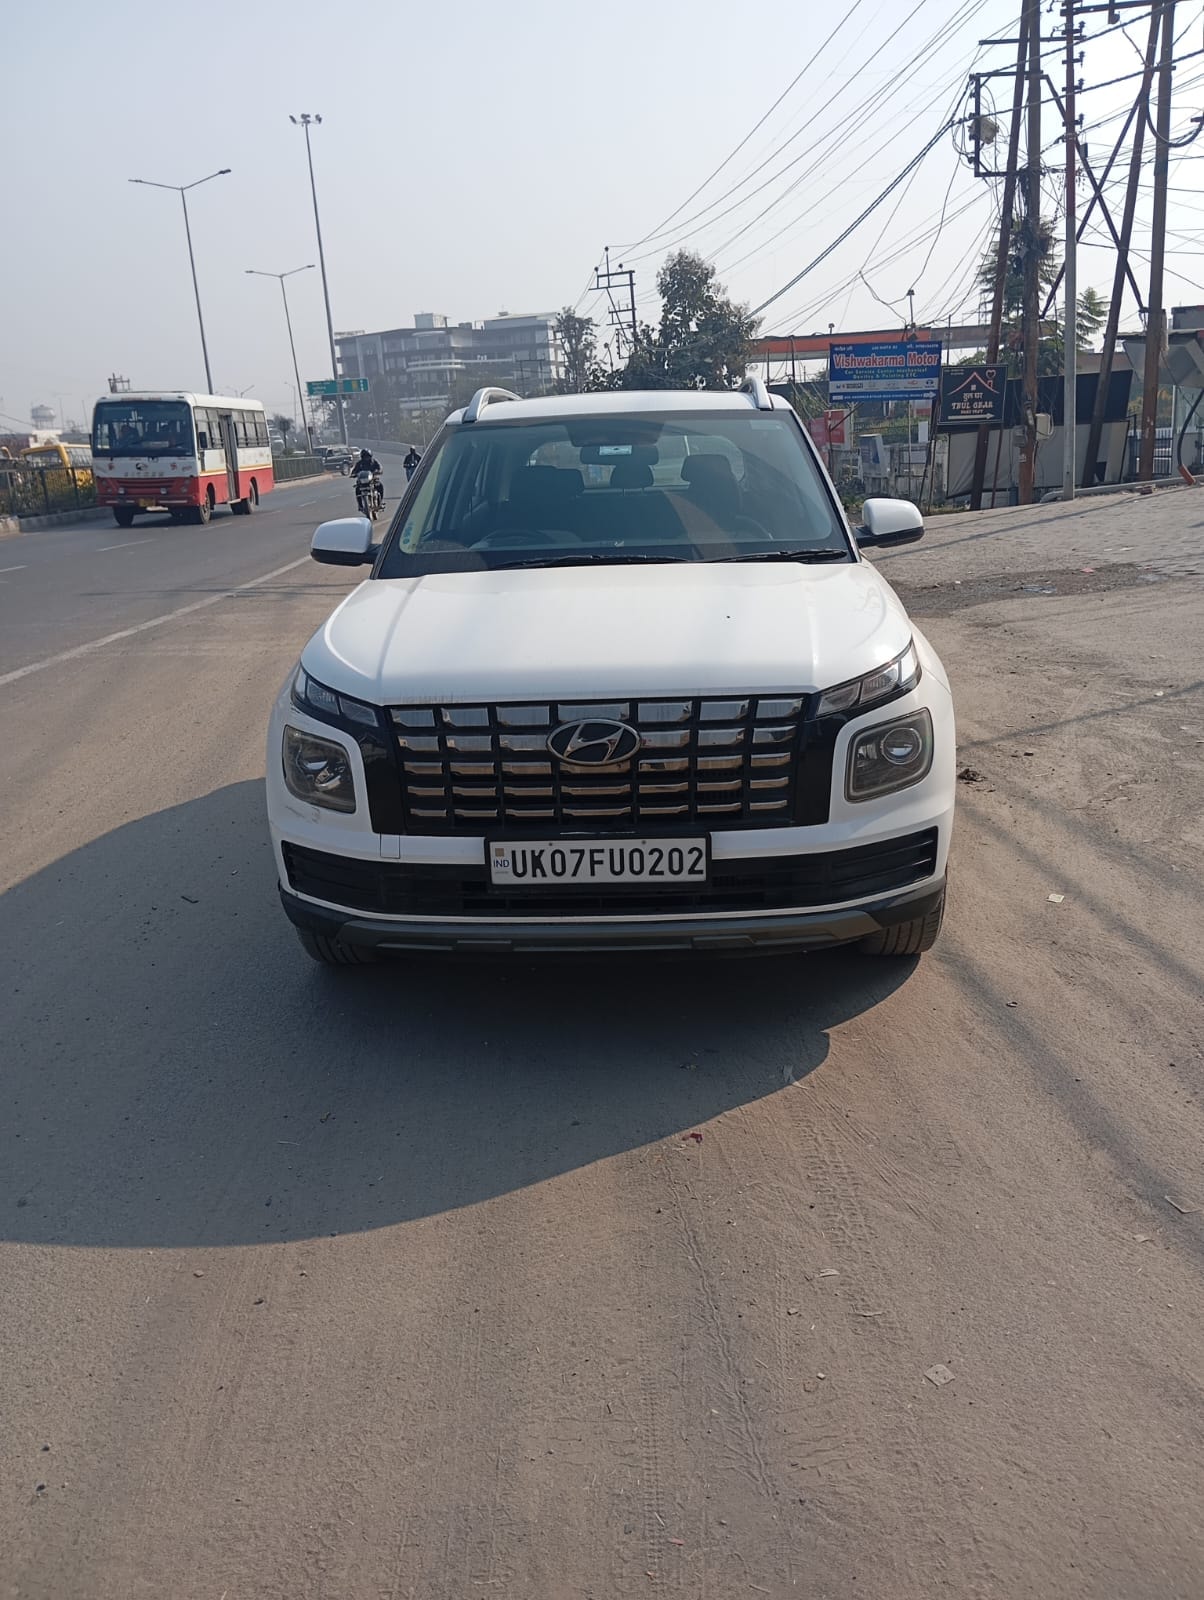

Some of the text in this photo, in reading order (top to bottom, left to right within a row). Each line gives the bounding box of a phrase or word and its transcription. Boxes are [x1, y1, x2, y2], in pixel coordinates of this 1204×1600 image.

[833, 352, 939, 368] Vishwakarma Motor
[493, 860, 510, 869] IND
[511, 846, 704, 878] UK07FU0202
